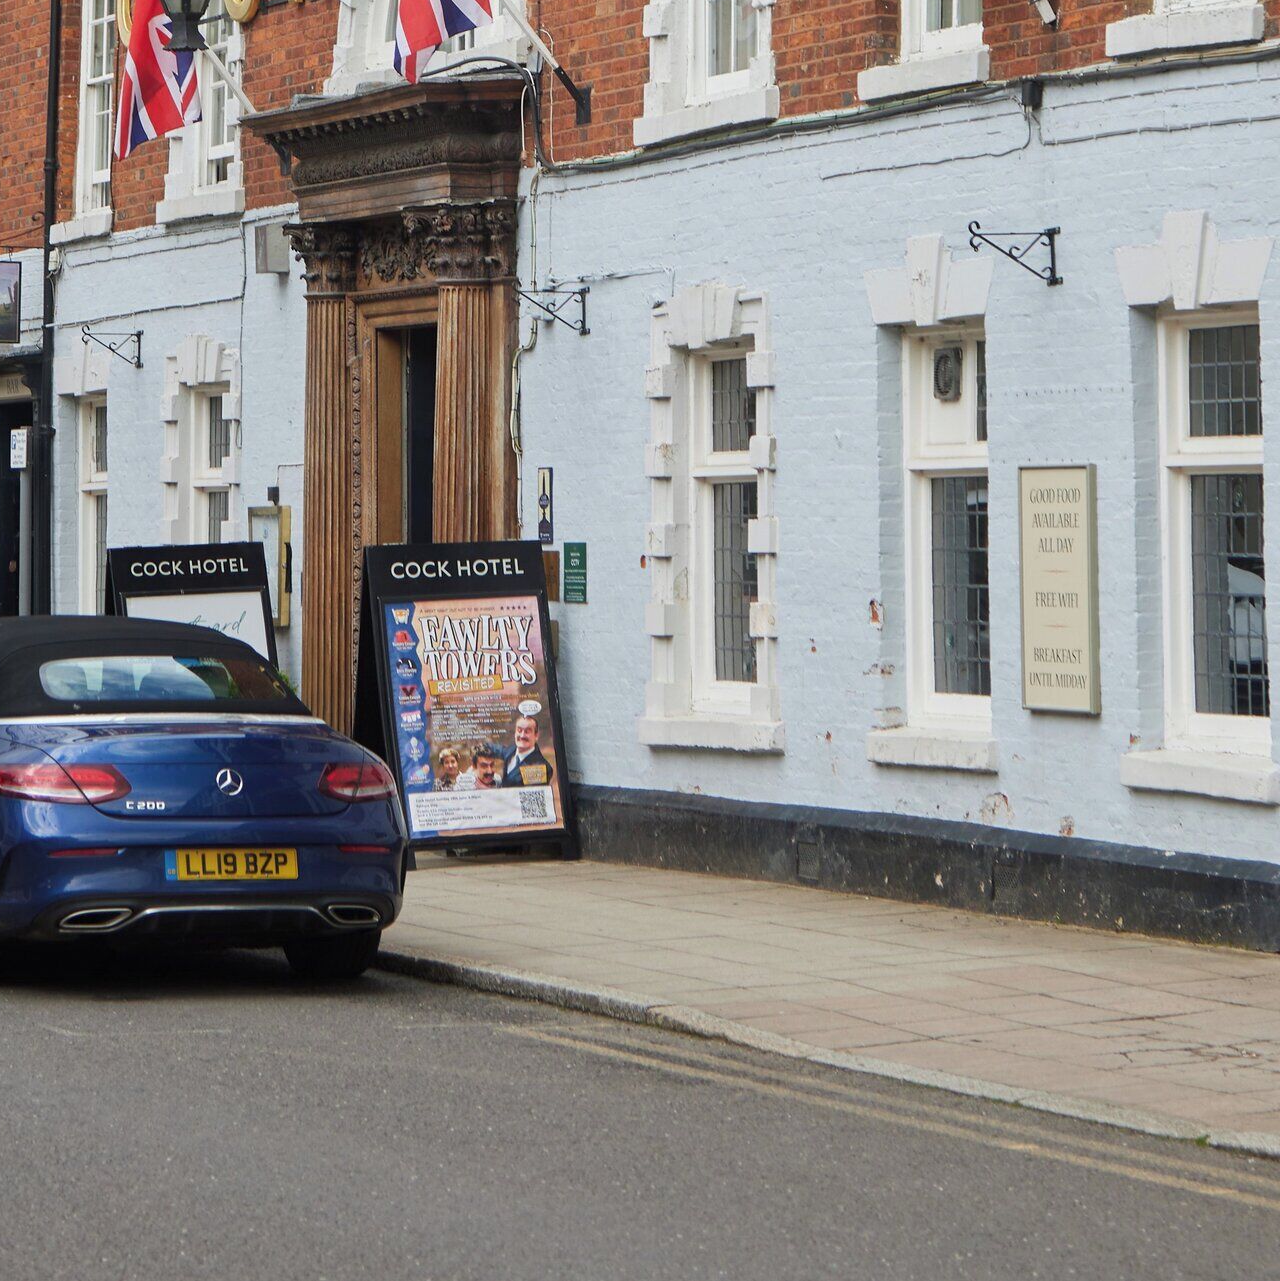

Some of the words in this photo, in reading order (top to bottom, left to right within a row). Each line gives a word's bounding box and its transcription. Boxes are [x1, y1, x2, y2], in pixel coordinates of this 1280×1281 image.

[1029, 488, 1056, 504] GOOD
[1057, 487, 1081, 504] FOOD
[1031, 512, 1080, 529] AVAILABLE
[1038, 537, 1056, 553] ALL
[1057, 537, 1074, 554] DAY
[130, 560, 185, 577] COCK
[189, 558, 249, 575] HOTEL
[390, 560, 452, 579] COCK
[457, 558, 525, 577] HOTEL
[1035, 592, 1059, 608] FREE
[1059, 592, 1079, 609] WIFI
[418, 615, 534, 652] FAWLTY
[1033, 647, 1083, 665] BREAKFAST
[422, 650, 538, 686] TOWERS
[437, 677, 495, 694] REVISITED
[1029, 672, 1055, 688] UNTIL
[1055, 673, 1087, 690] MIDDAY
[125, 800, 135, 810] C
[136, 800, 166, 810] 200
[184, 853, 238, 876] LL19
[244, 853, 288, 875] BZP
